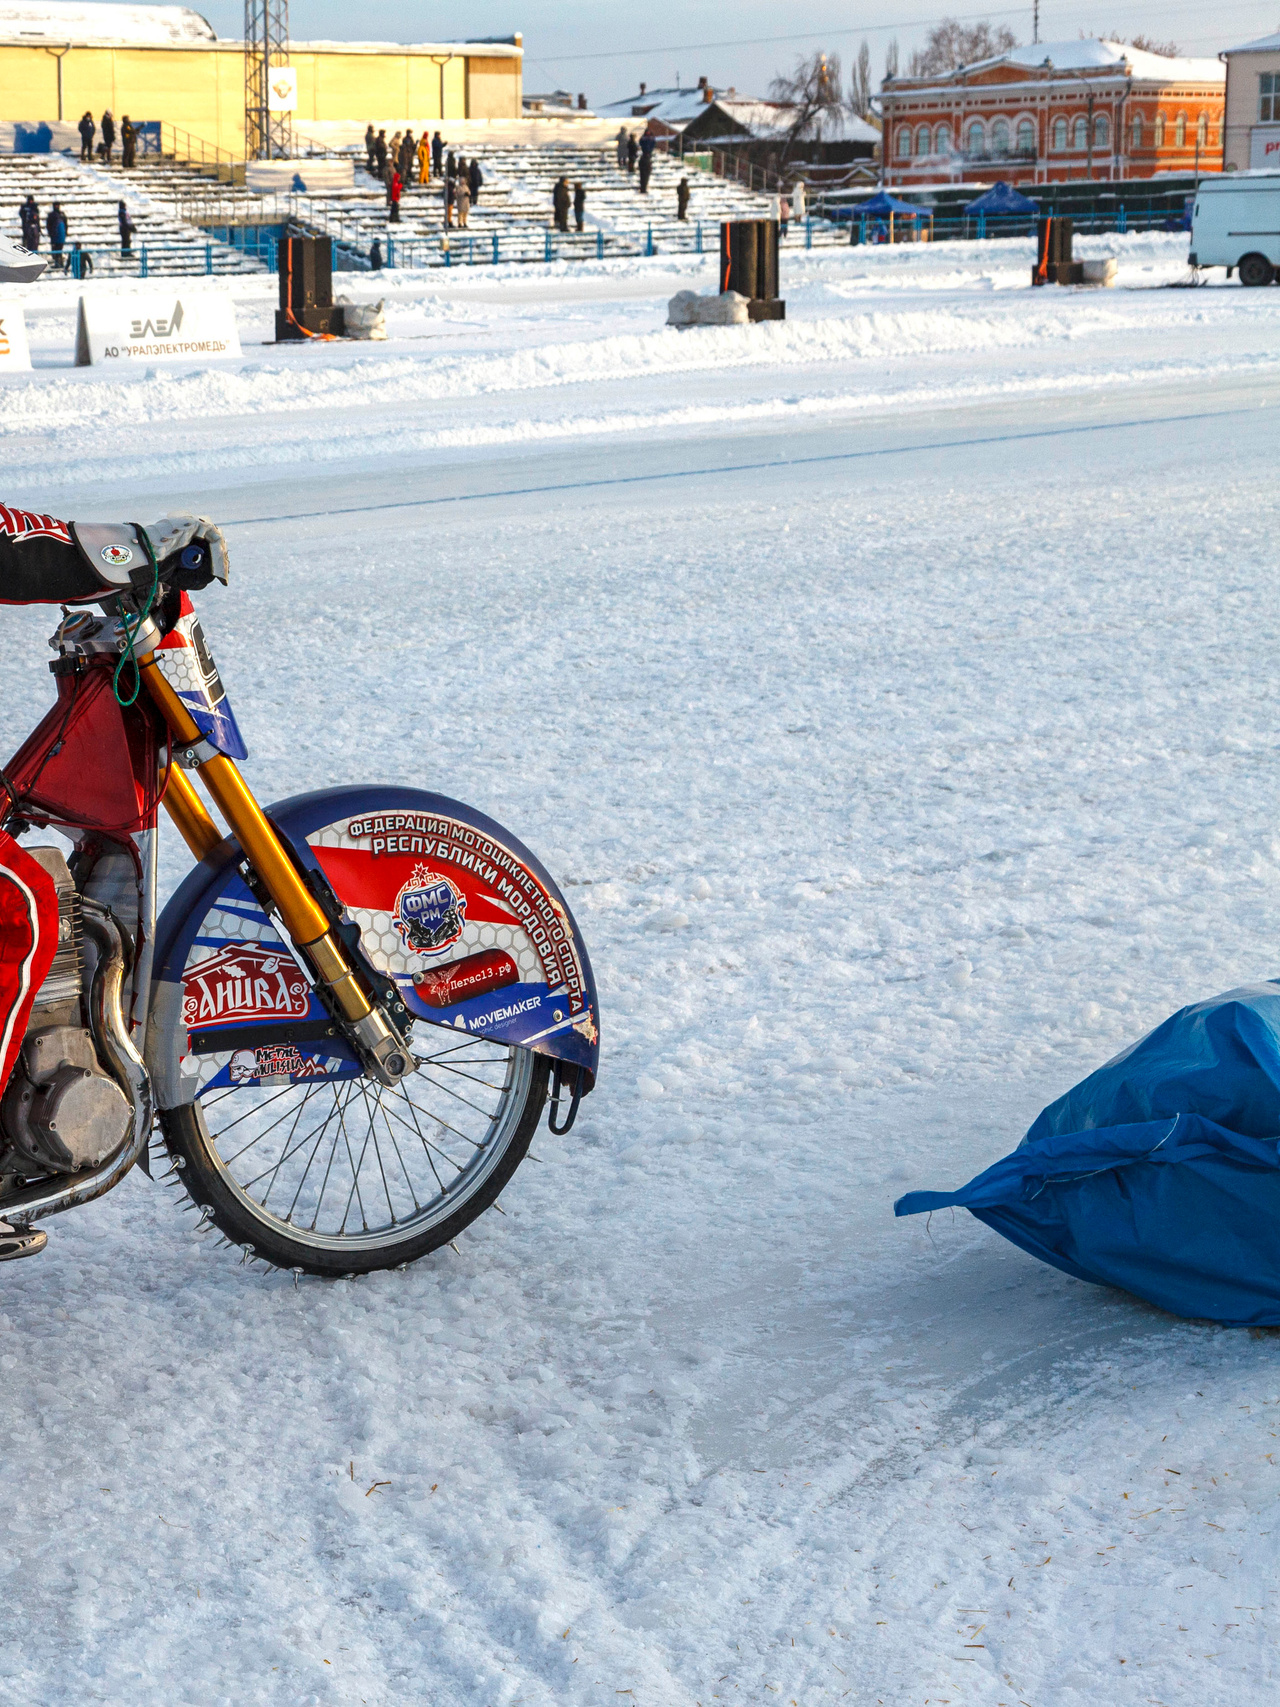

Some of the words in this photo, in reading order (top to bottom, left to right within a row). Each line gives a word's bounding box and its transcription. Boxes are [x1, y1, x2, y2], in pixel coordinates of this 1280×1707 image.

[104, 347, 120, 358] АО
[373, 836, 498, 884] РЕСПУБЛИКИ
[497, 878, 562, 986] МОРДОВИЯ
[405, 885, 450, 913] ФМС
[350, 816, 449, 836] ФЕДЕРАЦИЯ
[451, 825, 565, 942] МОТОЦИКЛЕТНОГО
[558, 941, 583, 1012] СПОРТА
[420, 909, 441, 924] РМ
[450, 962, 512, 990] Пегас13.рф
[468, 996, 542, 1030] MOVIEMAKER
